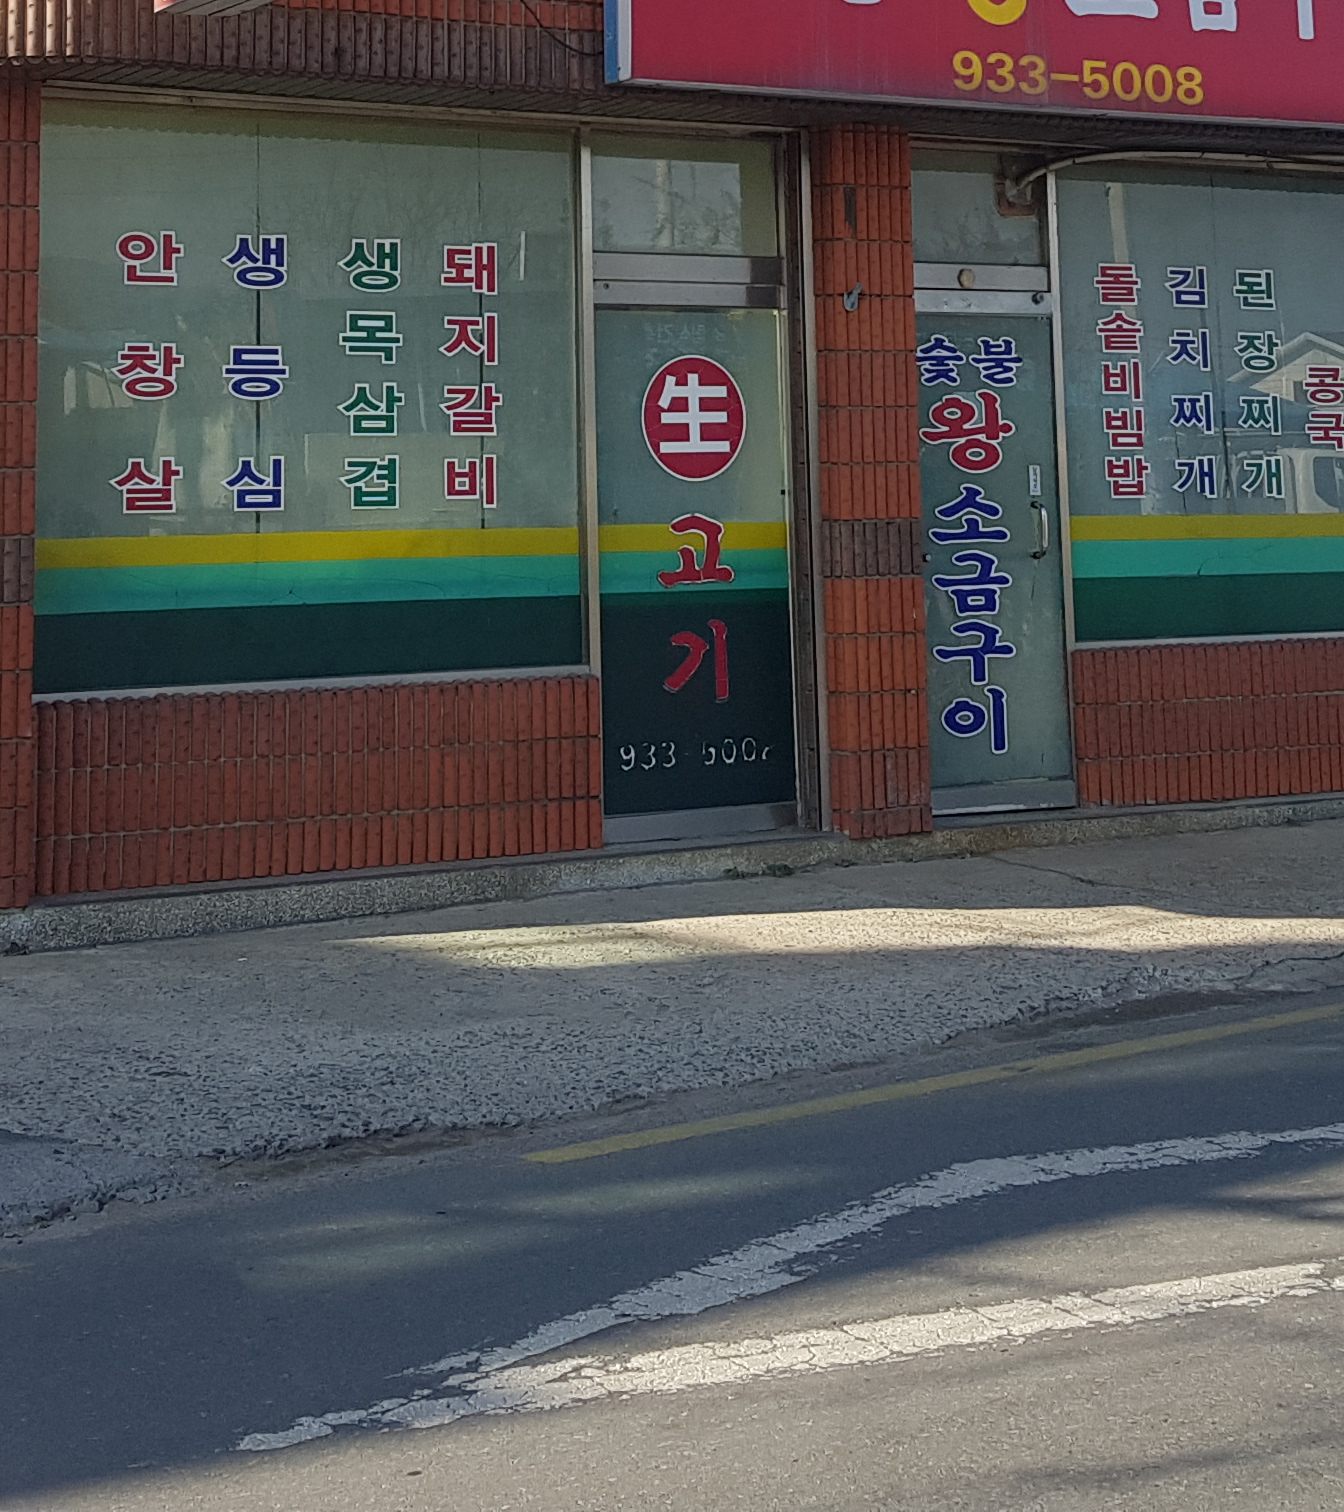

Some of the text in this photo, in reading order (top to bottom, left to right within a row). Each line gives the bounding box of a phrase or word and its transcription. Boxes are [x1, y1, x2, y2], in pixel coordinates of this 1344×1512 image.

[952, 49, 1205, 106] 933-5008
[439, 241, 503, 509] 돼지갈비
[1093, 263, 1150, 499] 돌솥비빔밥
[1165, 265, 1218, 499] 김치찌개
[1233, 268, 1285, 499] 된장찌개
[916, 334, 1023, 754] 숯불 왕 소금구이
